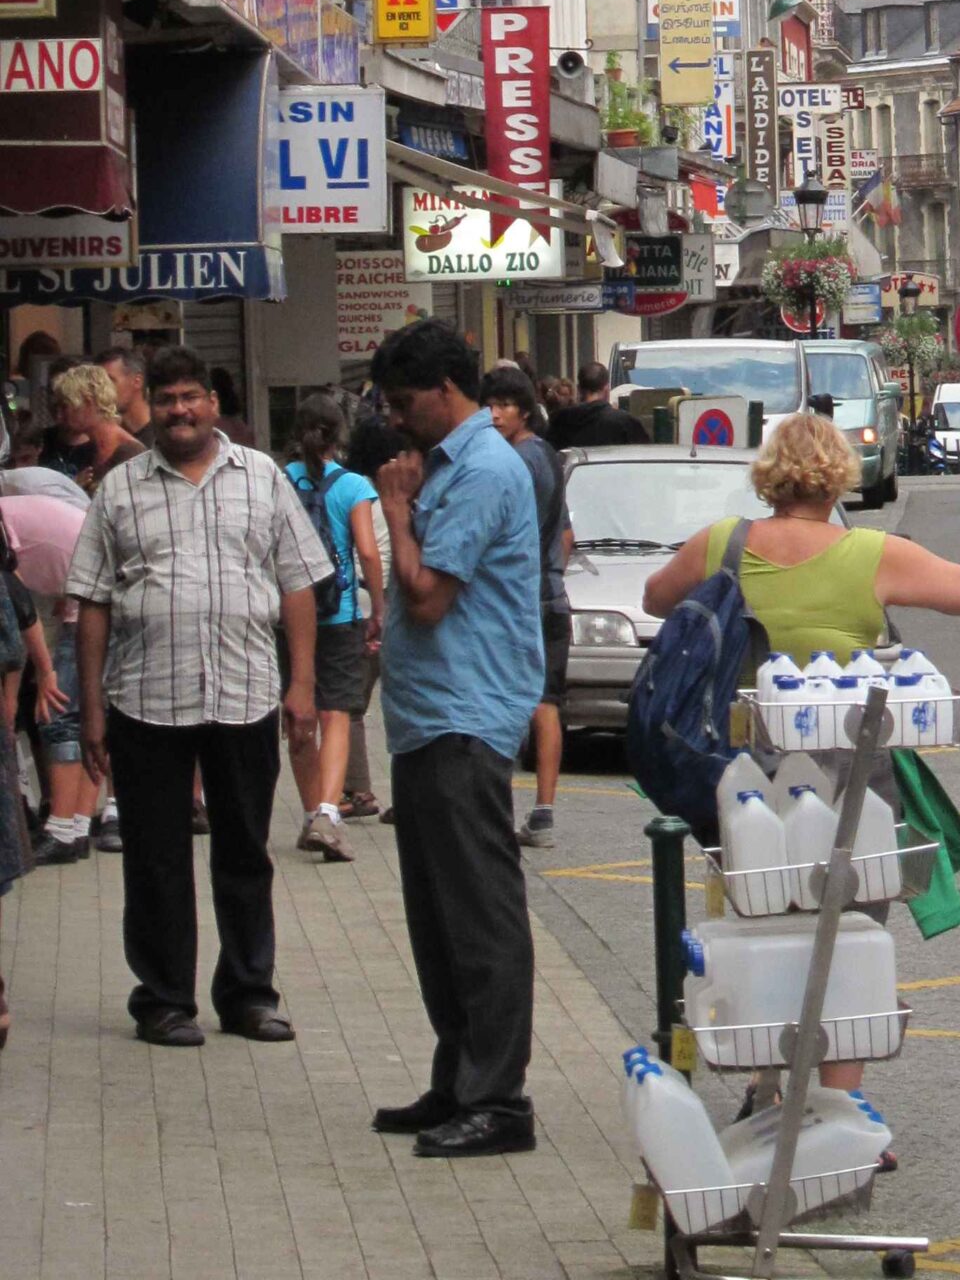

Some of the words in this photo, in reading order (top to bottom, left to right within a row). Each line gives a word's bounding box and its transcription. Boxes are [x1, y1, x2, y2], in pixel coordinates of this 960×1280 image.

[386, 11, 396, 21] EN
[398, 10, 421, 21] VENTE
[0, 40, 100, 92] ANO
[751, 57, 769, 188] L'ARDIDE
[93, 251, 247, 291] JULIEN
[428, 254, 492, 274] DALLO
[506, 252, 540, 271] ZIO
[338, 302, 403, 311] CHOCOLATS
[338, 314, 382, 323] QUICHES
[338, 325, 380, 334] PIZZAS
